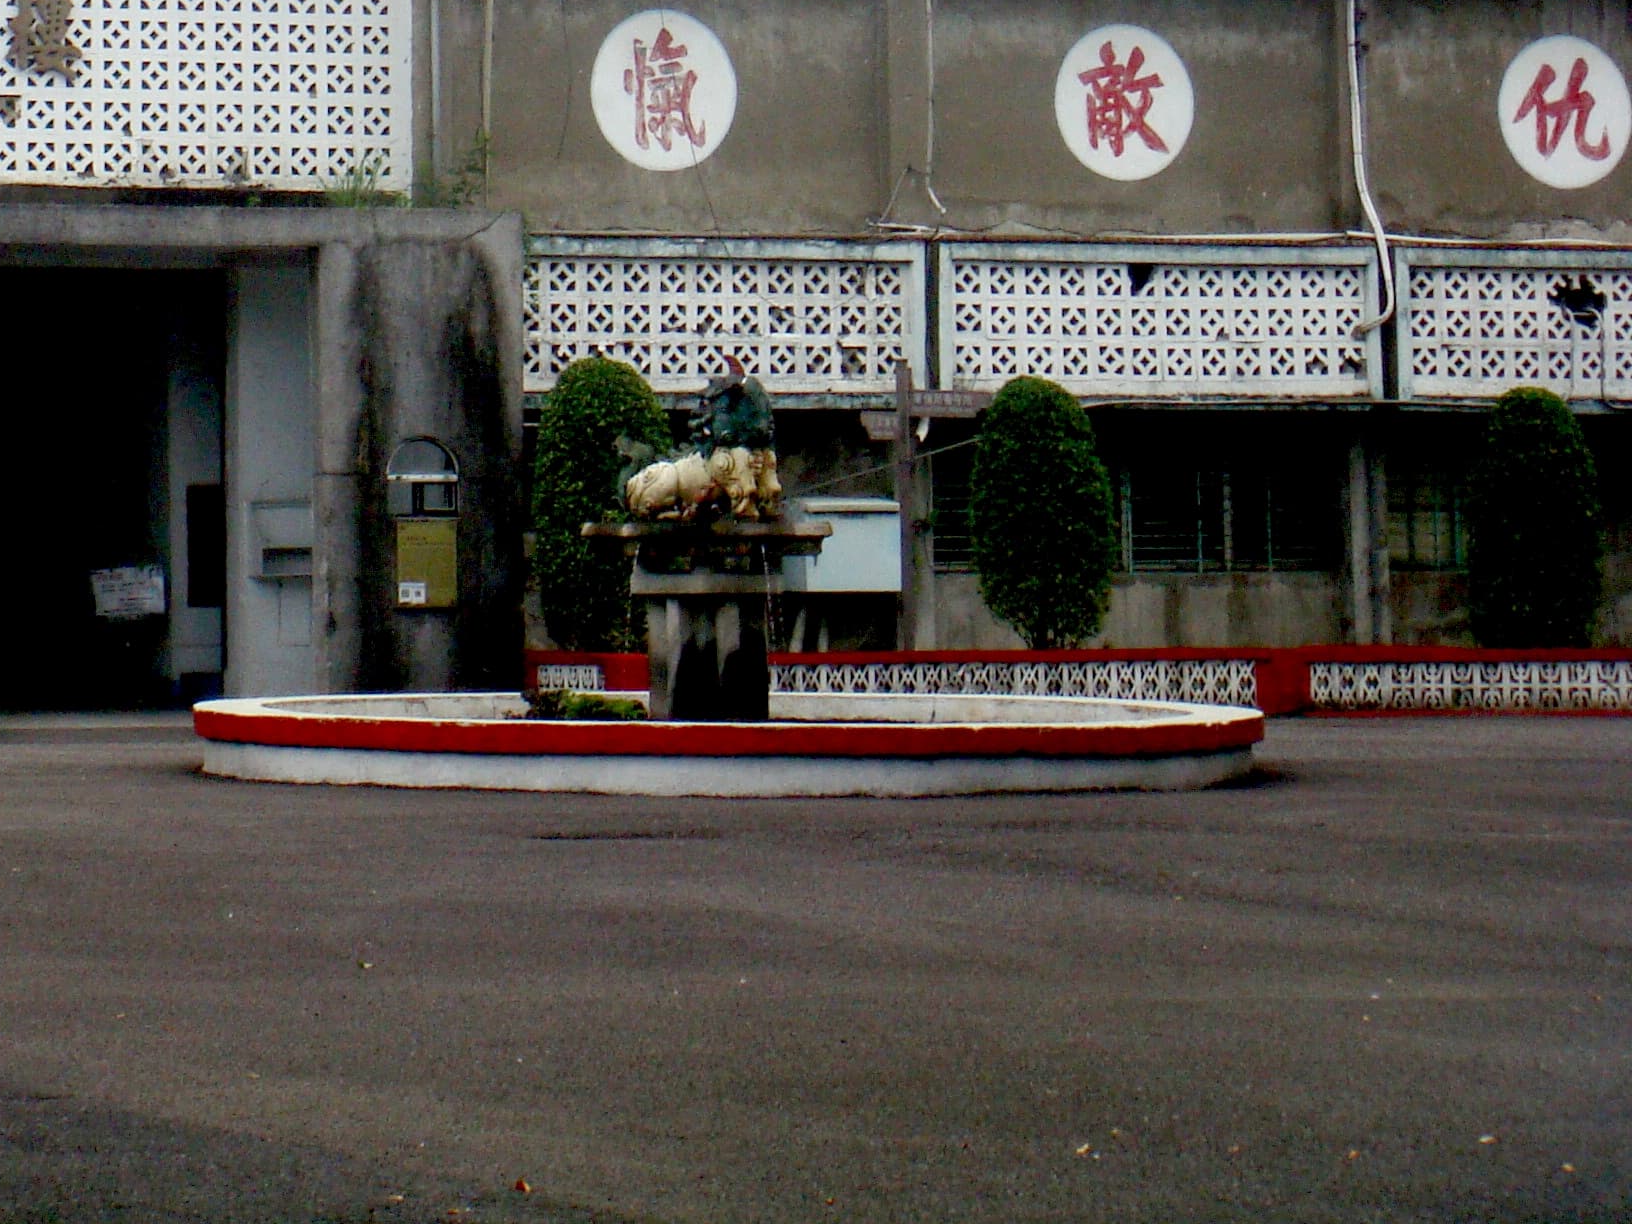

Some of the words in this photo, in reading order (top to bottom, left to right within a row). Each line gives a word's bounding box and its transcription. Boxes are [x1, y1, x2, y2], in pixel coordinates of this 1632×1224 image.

[623, 27, 706, 152] 愾
[1078, 40, 1170, 158] 敵
[1512, 57, 1611, 161] 仇
